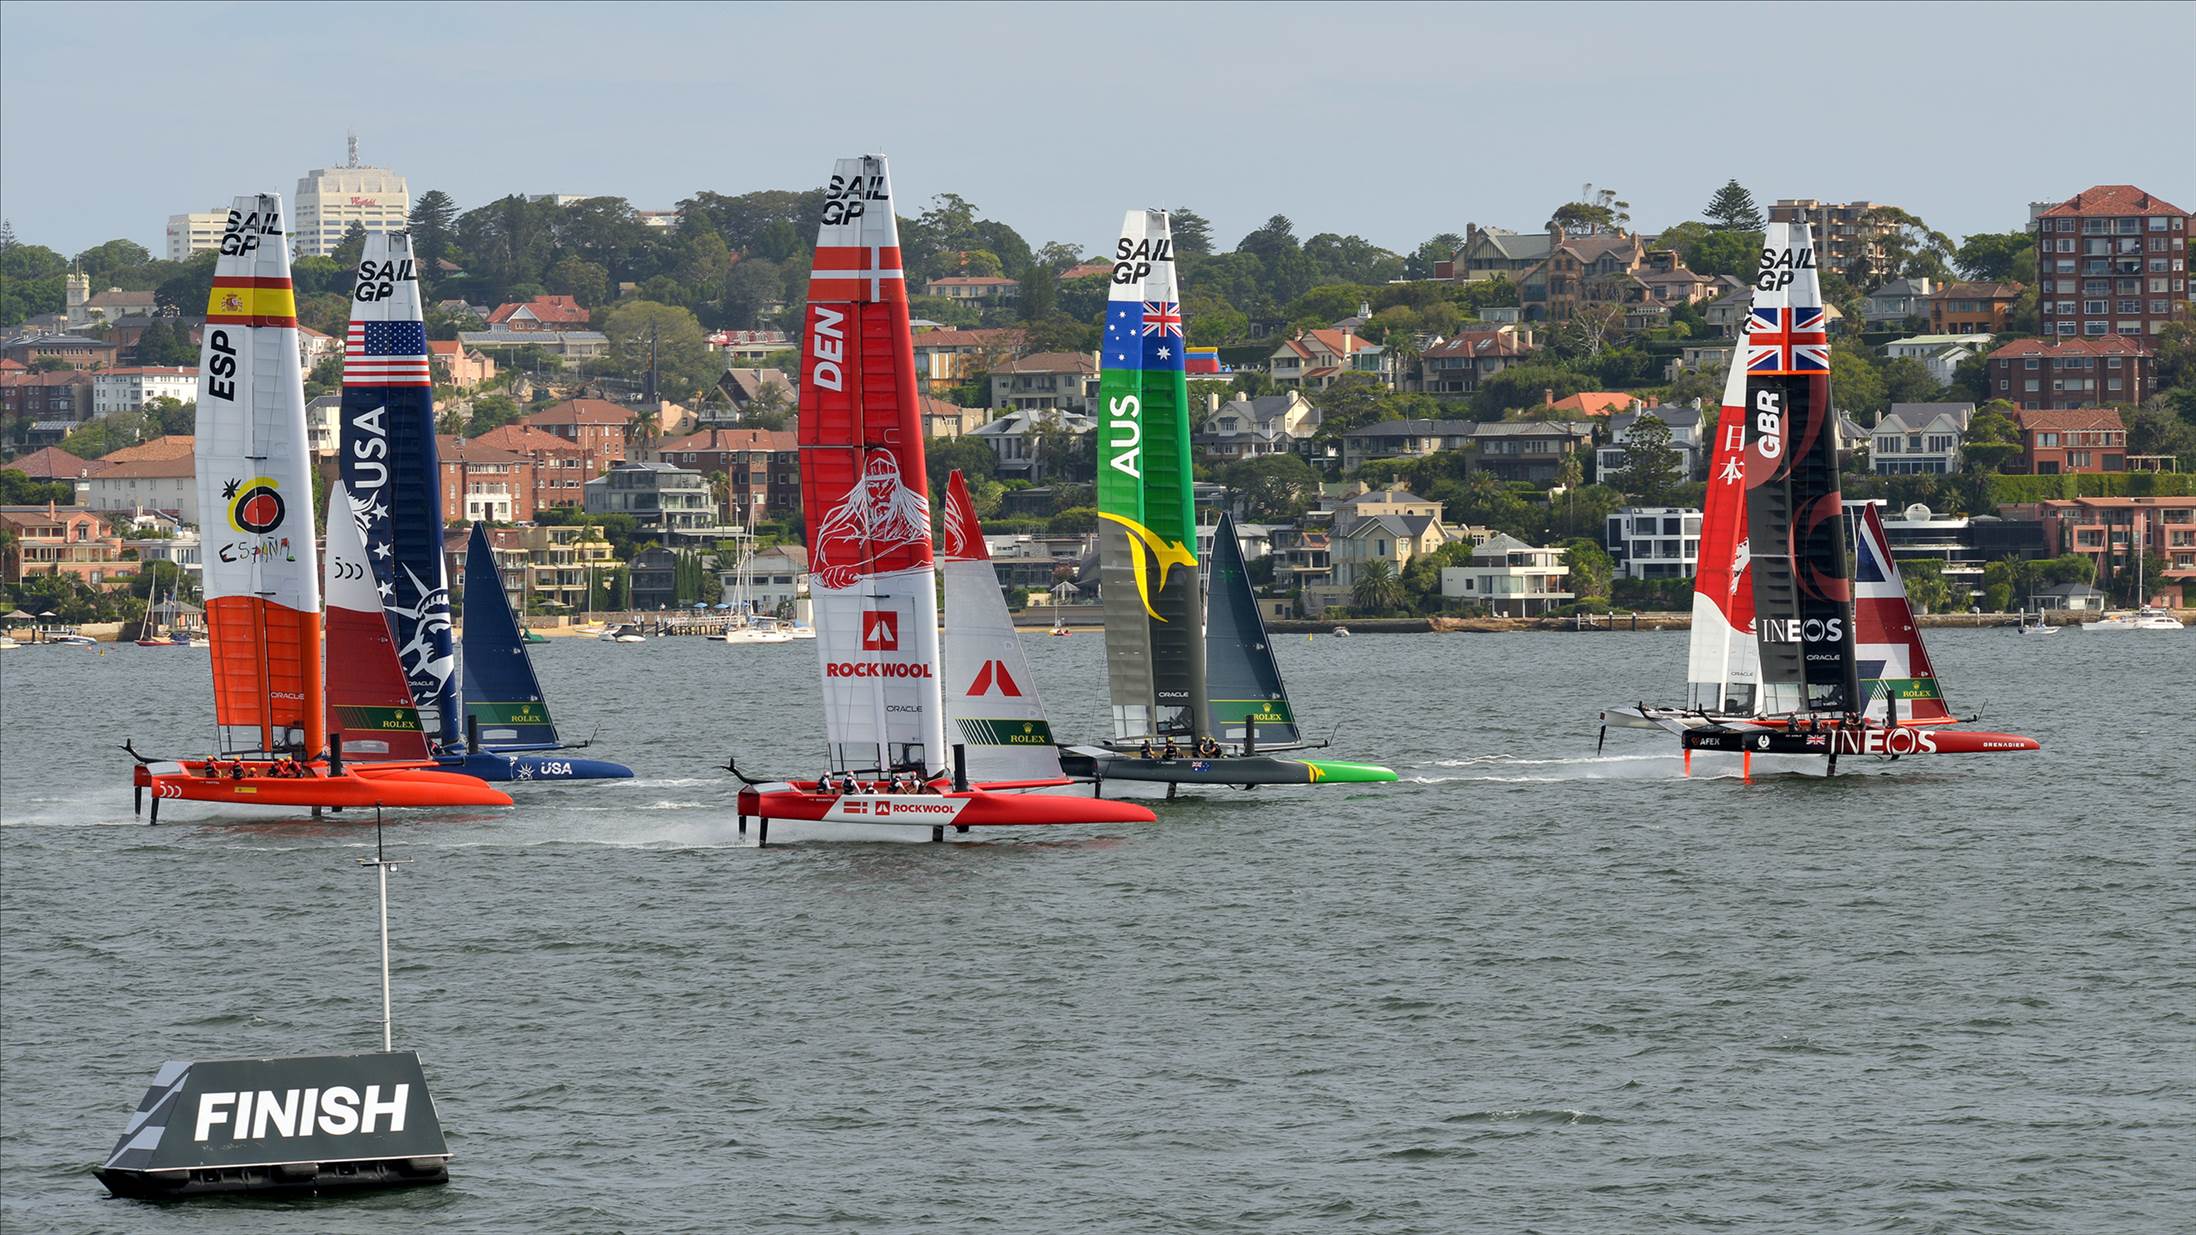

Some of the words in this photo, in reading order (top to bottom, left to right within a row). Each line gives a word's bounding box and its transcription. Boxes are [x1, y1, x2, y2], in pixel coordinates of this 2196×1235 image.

[826, 175, 889, 200] SAIL
[225, 210, 283, 236] SAIL
[821, 201, 865, 225] GP
[220, 233, 260, 257] GP
[1116, 238, 1174, 261] SAIL
[1760, 248, 1816, 269] SAIL
[358, 259, 418, 282] SAIL
[1112, 262, 1151, 284] GP
[1756, 270, 1794, 291] GP
[355, 282, 394, 302] GP
[813, 306, 844, 393] DEN
[208, 329, 237, 402] ESP
[1757, 390, 1780, 459] GBR
[353, 406, 388, 488] USA
[1110, 395, 1141, 479] AUS
[1718, 424, 1746, 485] 日本
[1762, 618, 1843, 642] INEOS
[826, 663, 933, 678] ROCKWOOL
[270, 691, 304, 700] ORACLE
[511, 715, 541, 723] ROLEX
[886, 705, 923, 713] ORACLE
[1253, 713, 1282, 721] ROLEX
[382, 720, 415, 729] ROLEX
[1010, 735, 1046, 744] ROLEX
[1700, 737, 1720, 746] AFEX
[1830, 728, 1937, 754] INEOS
[540, 762, 573, 776] USA
[893, 804, 955, 814] ROCKWOOL
[194, 1083, 410, 1142] FINISH
